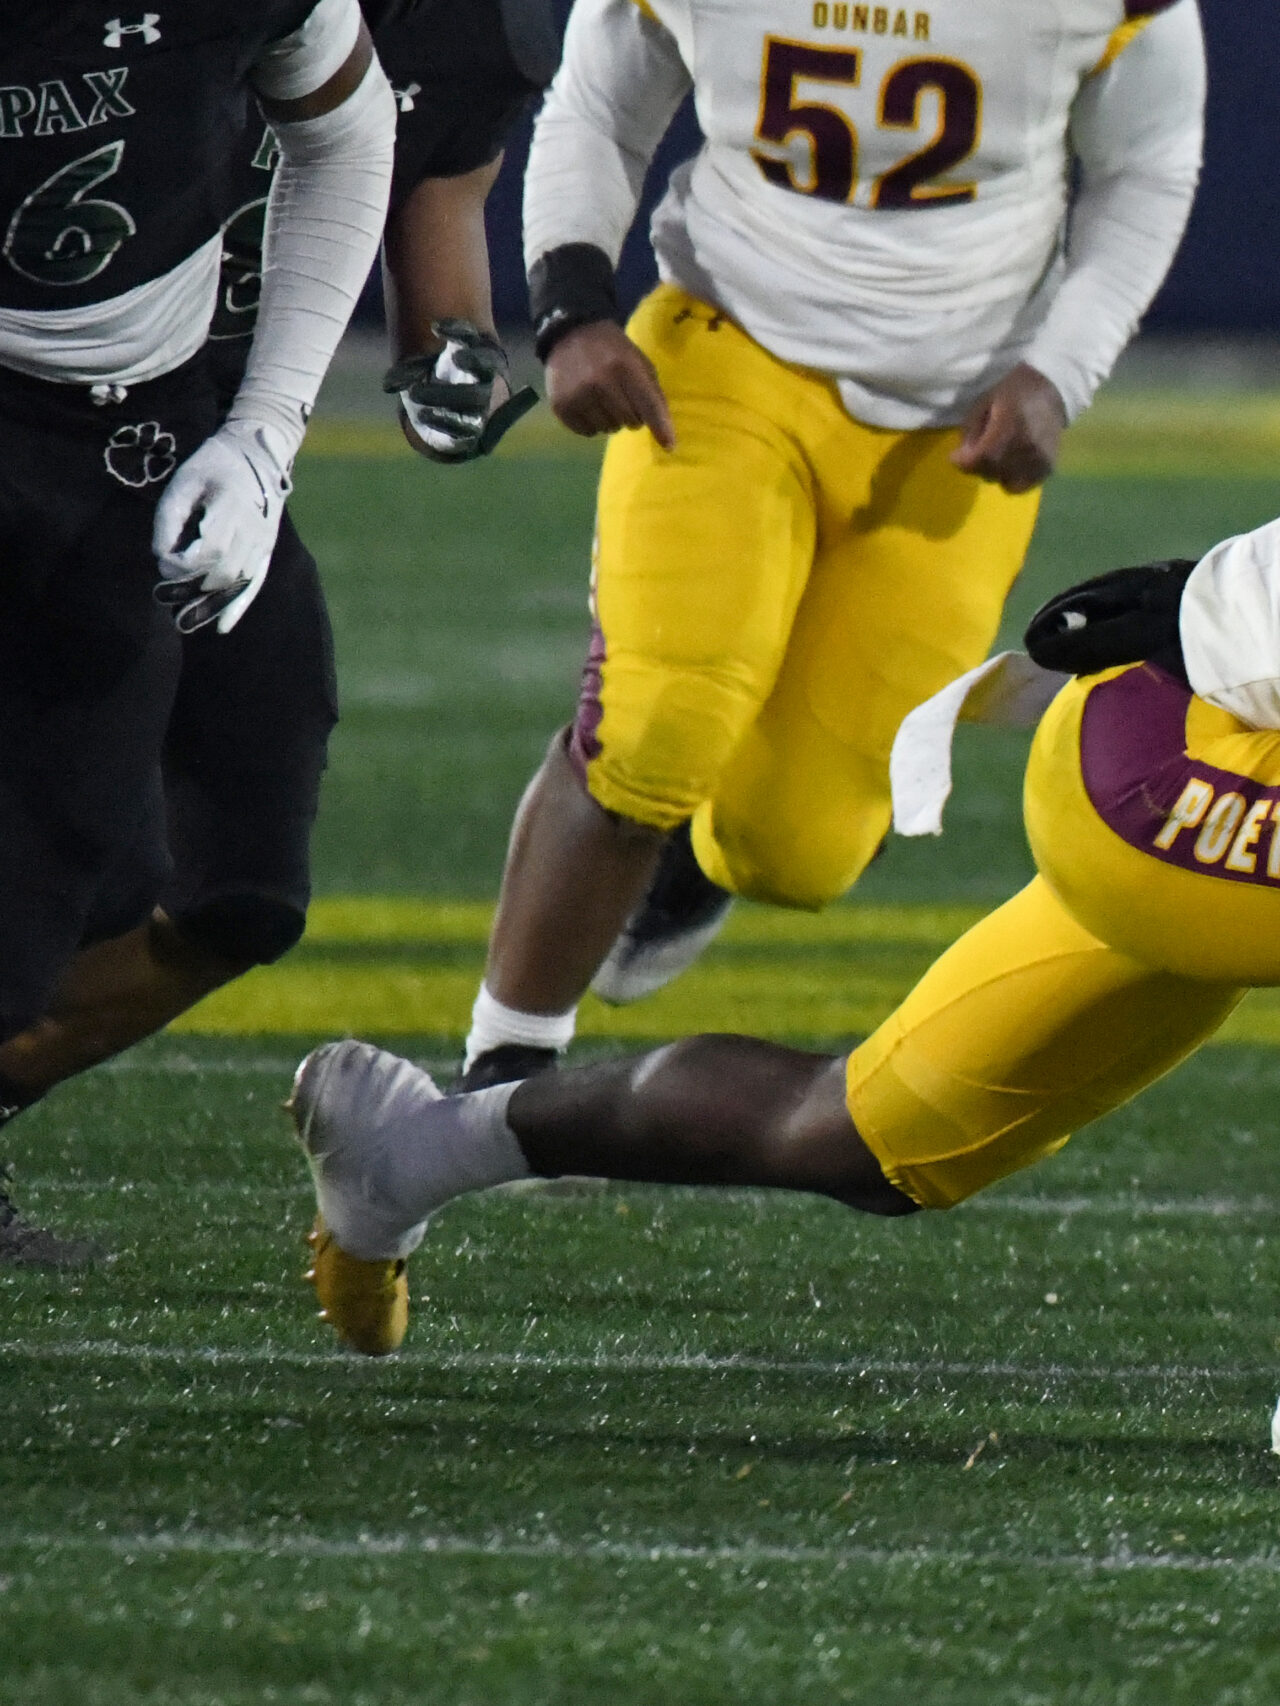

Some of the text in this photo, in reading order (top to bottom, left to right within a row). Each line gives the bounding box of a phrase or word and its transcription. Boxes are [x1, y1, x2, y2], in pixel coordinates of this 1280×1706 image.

[812, 1, 932, 41] DUNBAR
[0, 66, 137, 138] PAX
[748, 34, 983, 210] 52
[3, 139, 137, 286] 6
